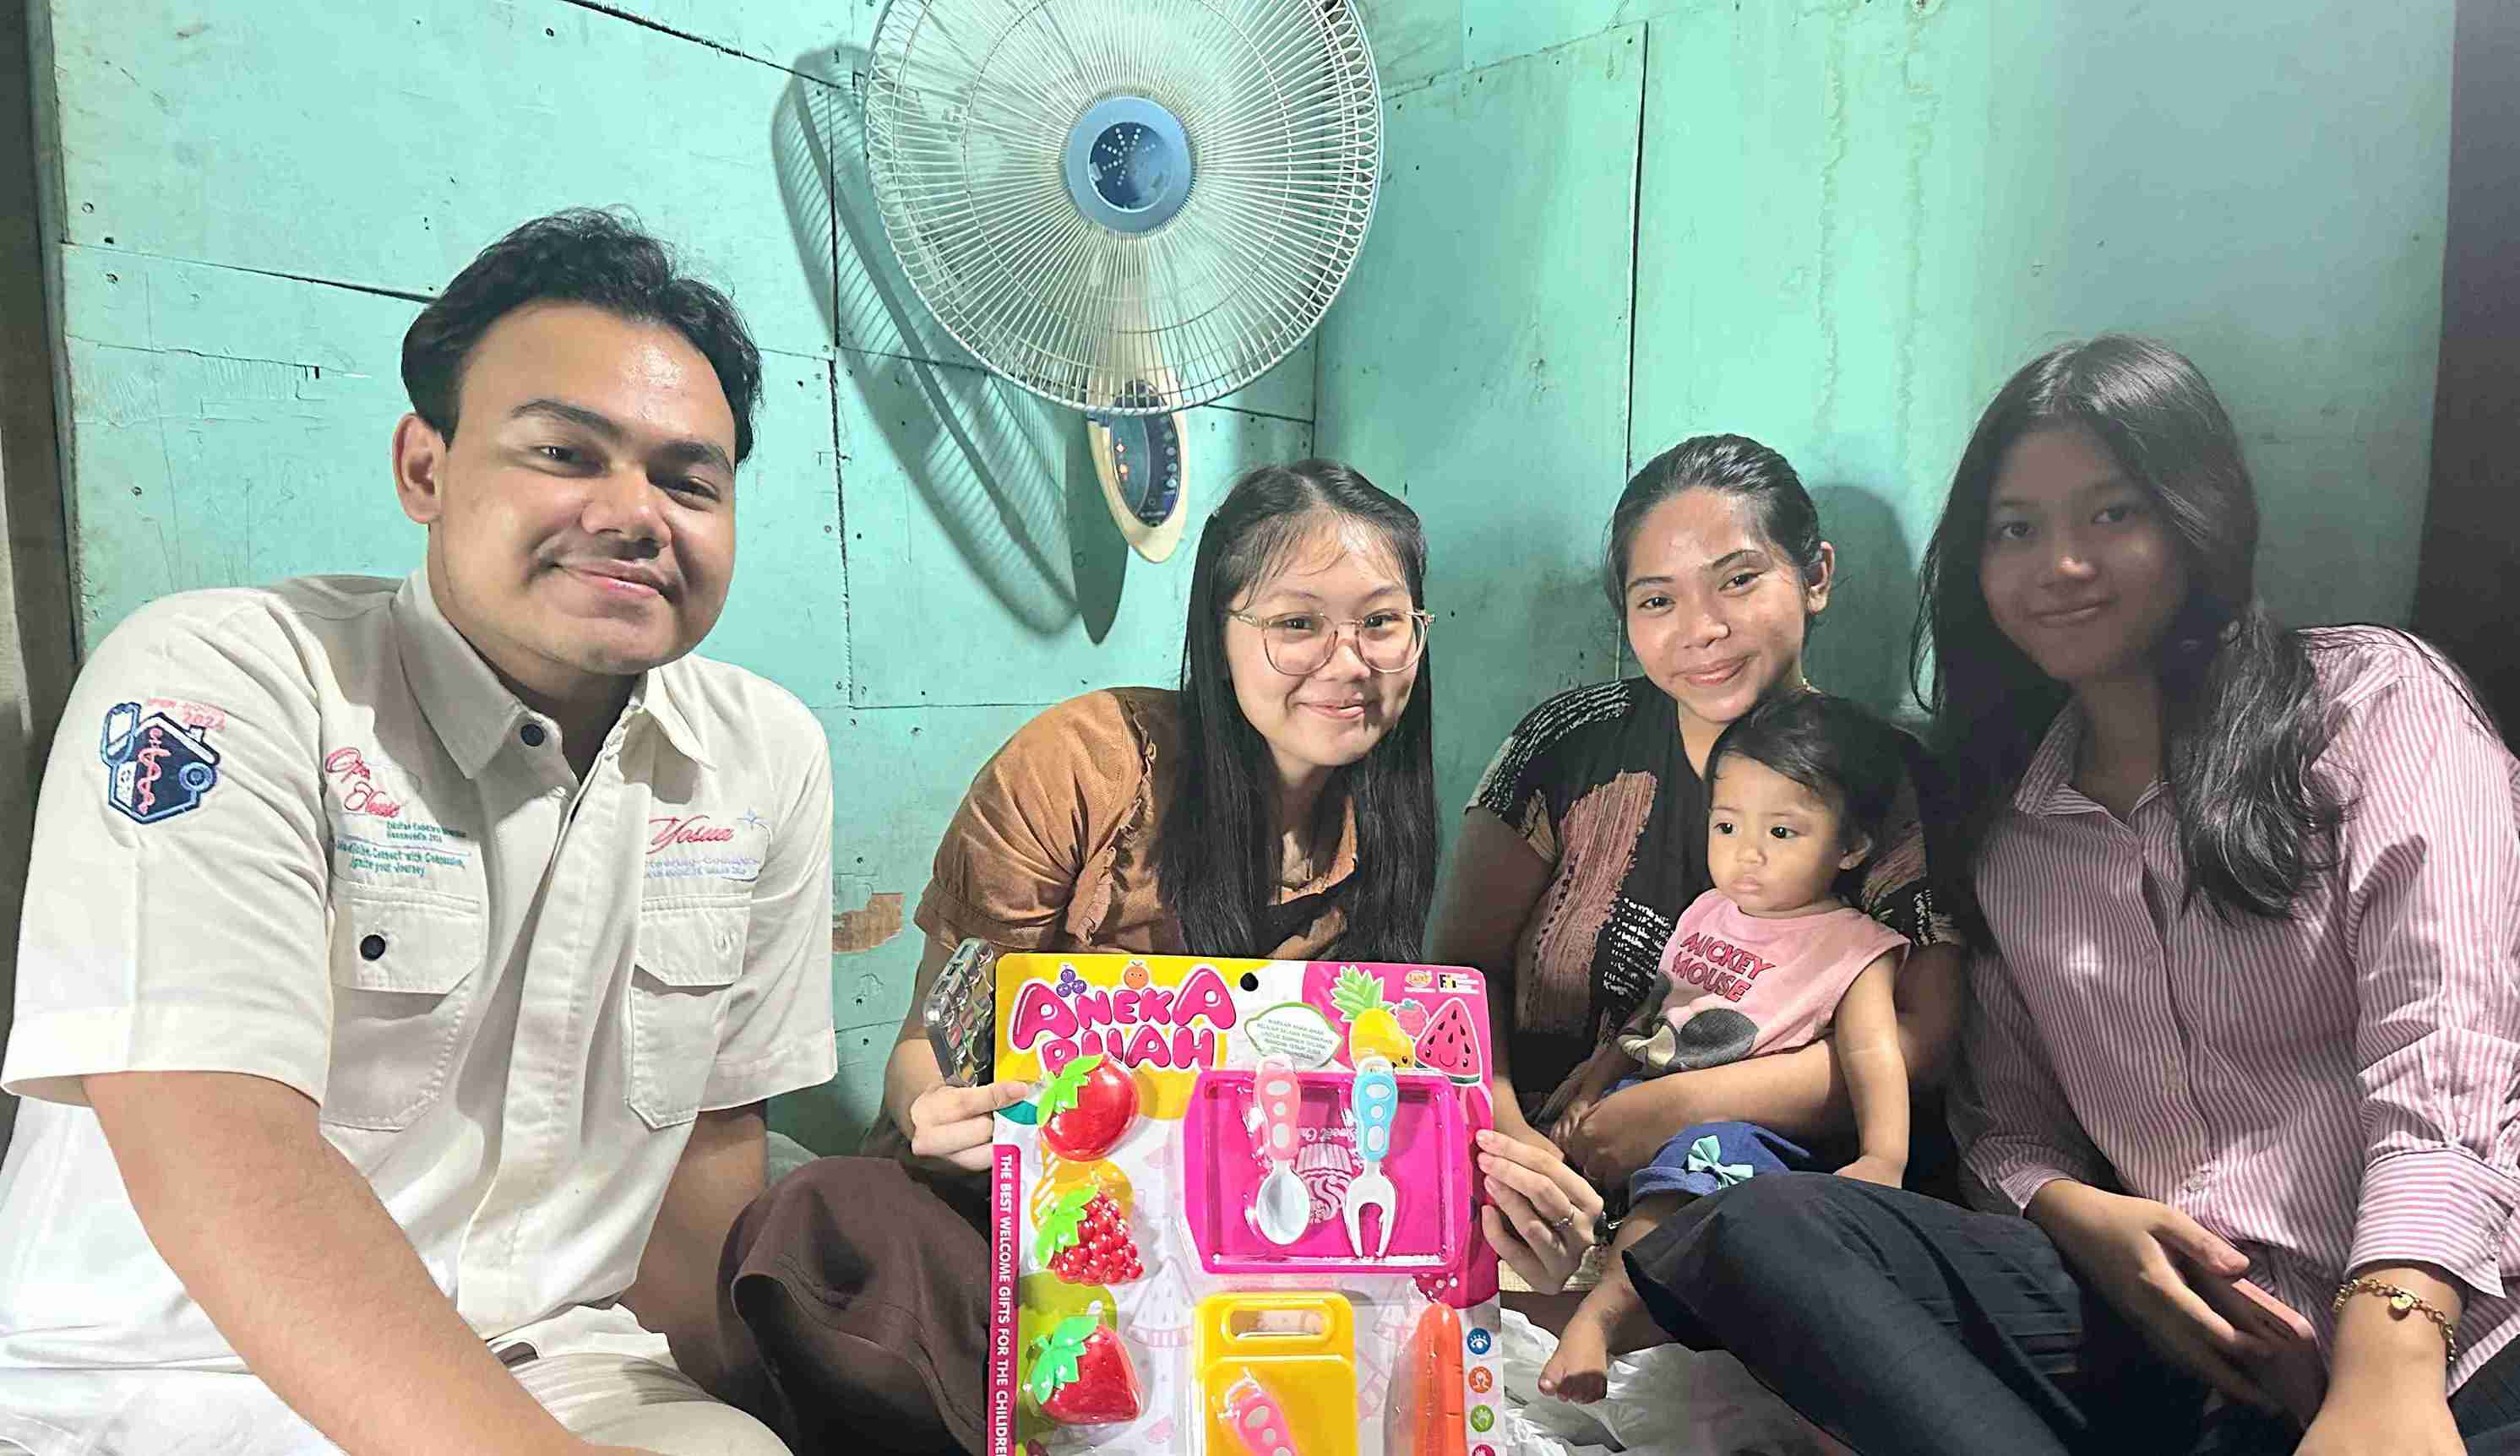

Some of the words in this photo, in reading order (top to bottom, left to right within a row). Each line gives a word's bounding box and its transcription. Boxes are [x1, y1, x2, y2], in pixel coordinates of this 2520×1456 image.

[1679, 932, 1777, 980] MICKEY
[1671, 952, 1752, 1002] MOUSE
[1013, 968, 1238, 1050] ANEKA
[999, 1154, 1012, 1179] THE
[999, 1184, 1012, 1214] BEST
[999, 1216, 1012, 1282] WELCOME
[997, 1286, 1011, 1324] GIFTS
[996, 1328, 1010, 1356] FOR
[996, 1360, 1009, 1386] THE
